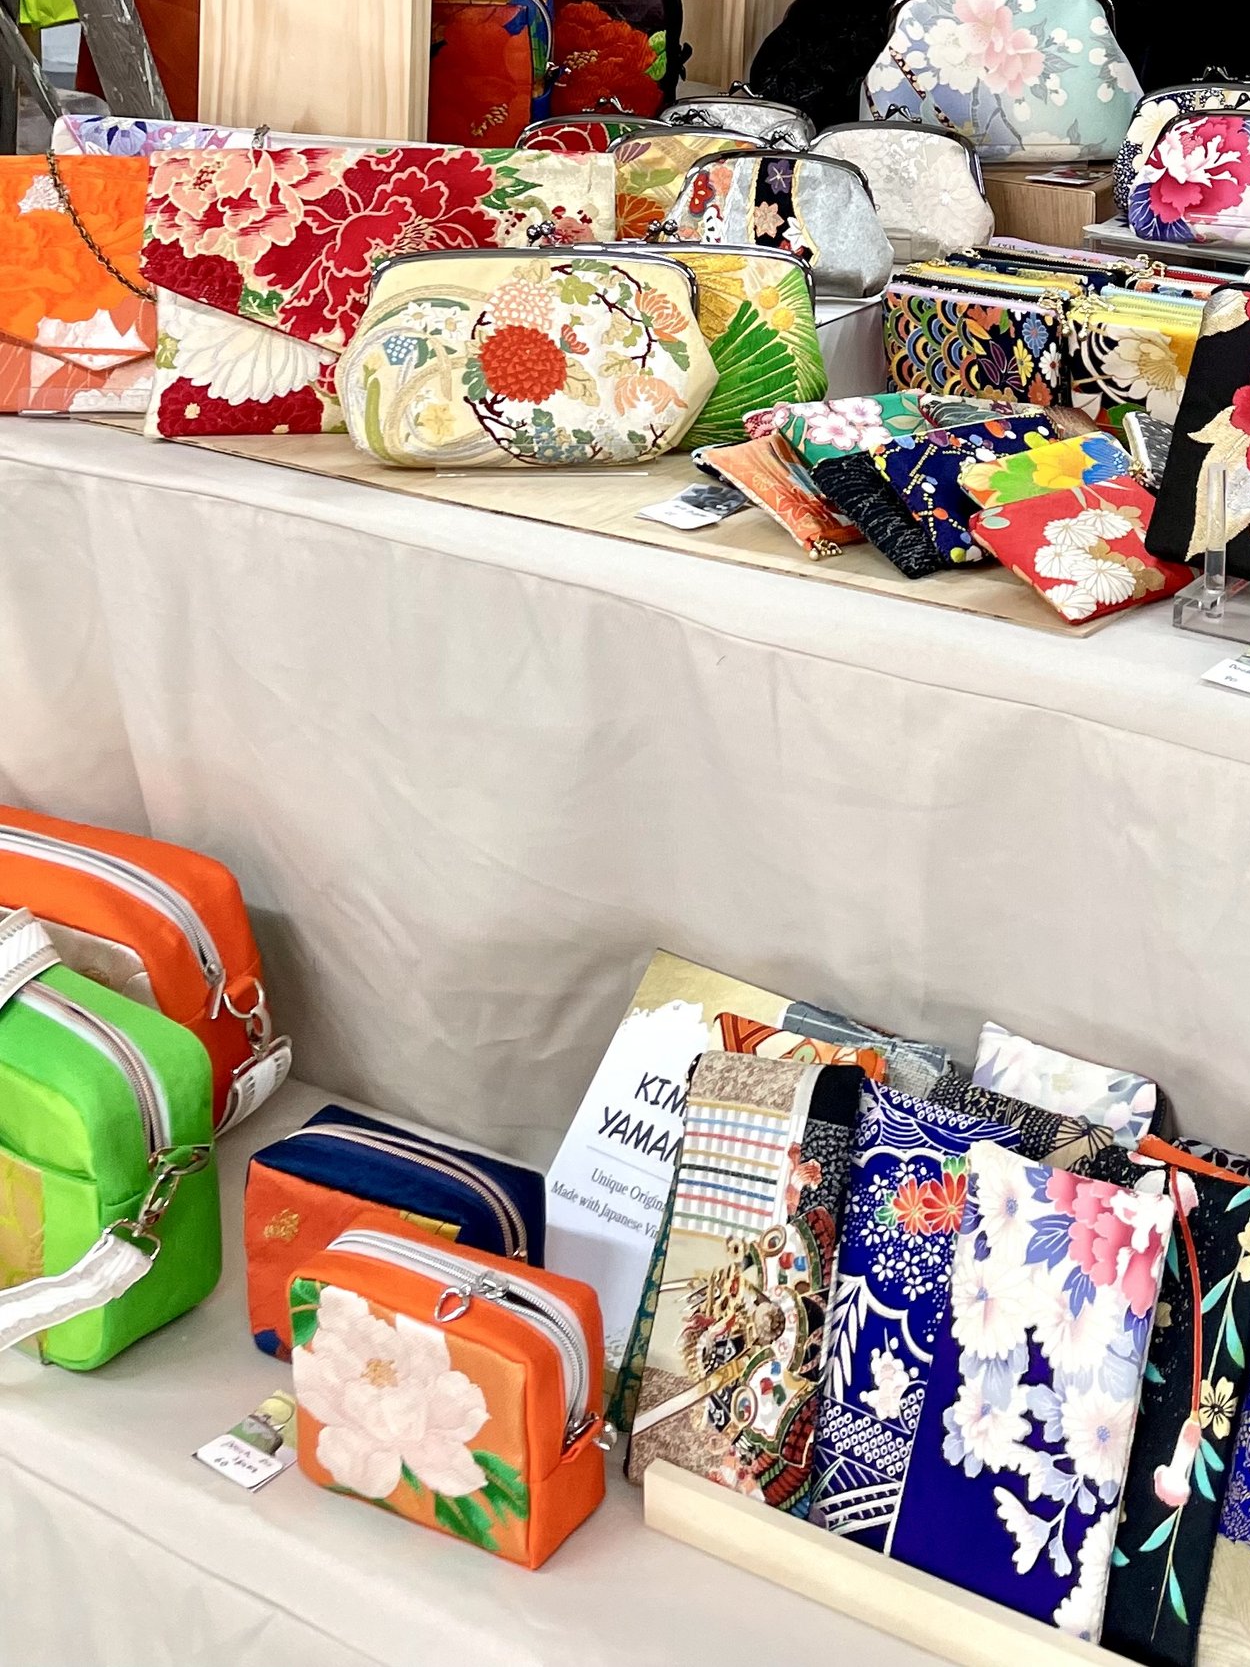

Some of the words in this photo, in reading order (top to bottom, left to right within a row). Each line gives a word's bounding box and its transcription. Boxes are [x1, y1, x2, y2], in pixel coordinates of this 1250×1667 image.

[634, 1072, 687, 1117] KIM
[551, 1180, 579, 1204] Made
[580, 1196, 601, 1214] with
[597, 1203, 643, 1231] Japanese
[591, 1168, 629, 1195] Unique
[630, 1185, 665, 1212] Origin
